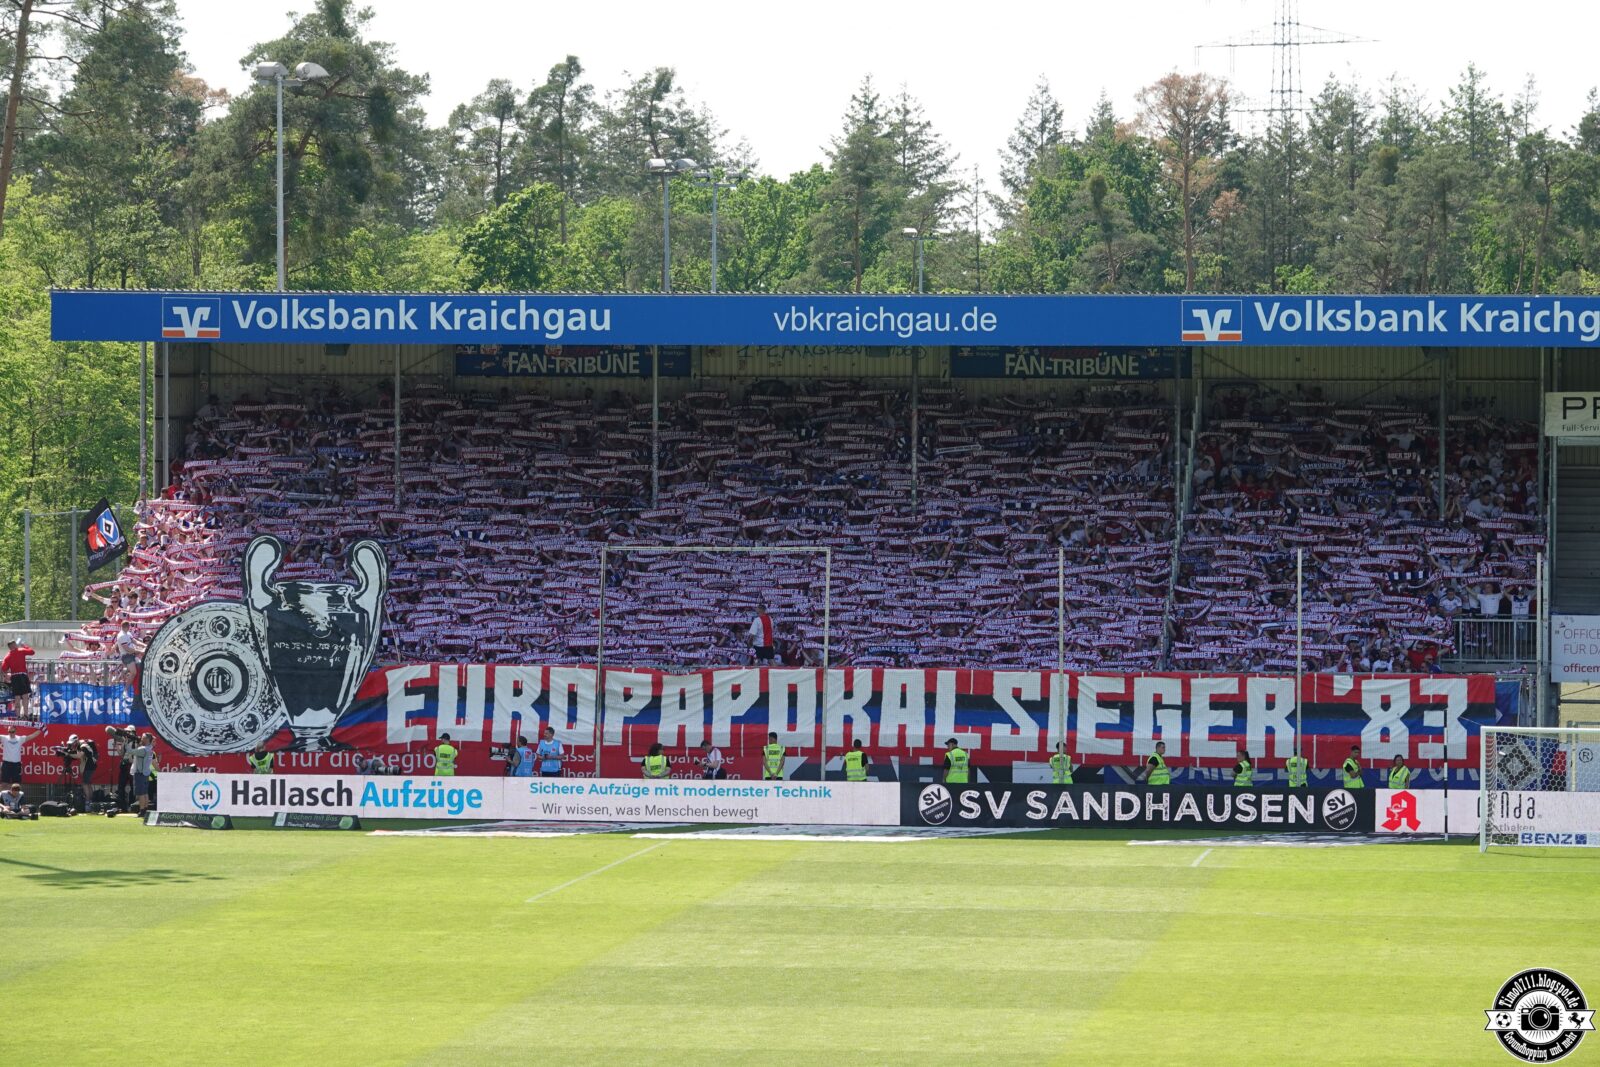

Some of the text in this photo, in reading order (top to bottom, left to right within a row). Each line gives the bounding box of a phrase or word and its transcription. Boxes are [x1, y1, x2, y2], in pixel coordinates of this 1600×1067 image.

[232, 299, 612, 339] Volksbank Kraichgau
[773, 306, 998, 338] vbkraichgau.de
[1254, 300, 1600, 341] Volksbank Kraichg
[507, 350, 641, 375] FAN-TRIBÜNE
[1005, 352, 1140, 376] FAN-TRIBÜNE
[385, 664, 1296, 758] EUROPAPOKALSIEGER
[199, 790, 213, 800] SH
[231, 779, 482, 815] Hallasch Aufzüge
[530, 782, 831, 799] Sichere Aufzüge mit modernster Technik
[922, 788, 942, 806] SV
[1327, 793, 1346, 811] SV
[541, 803, 563, 815] Wir
[566, 803, 611, 818] wissen,
[615, 806, 641, 816] was
[645, 804, 710, 817] Menschen
[713, 805, 759, 820] bewegt
[958, 790, 1315, 824] SV SANDHAUSEN
[1521, 833, 1573, 845] BENZ
